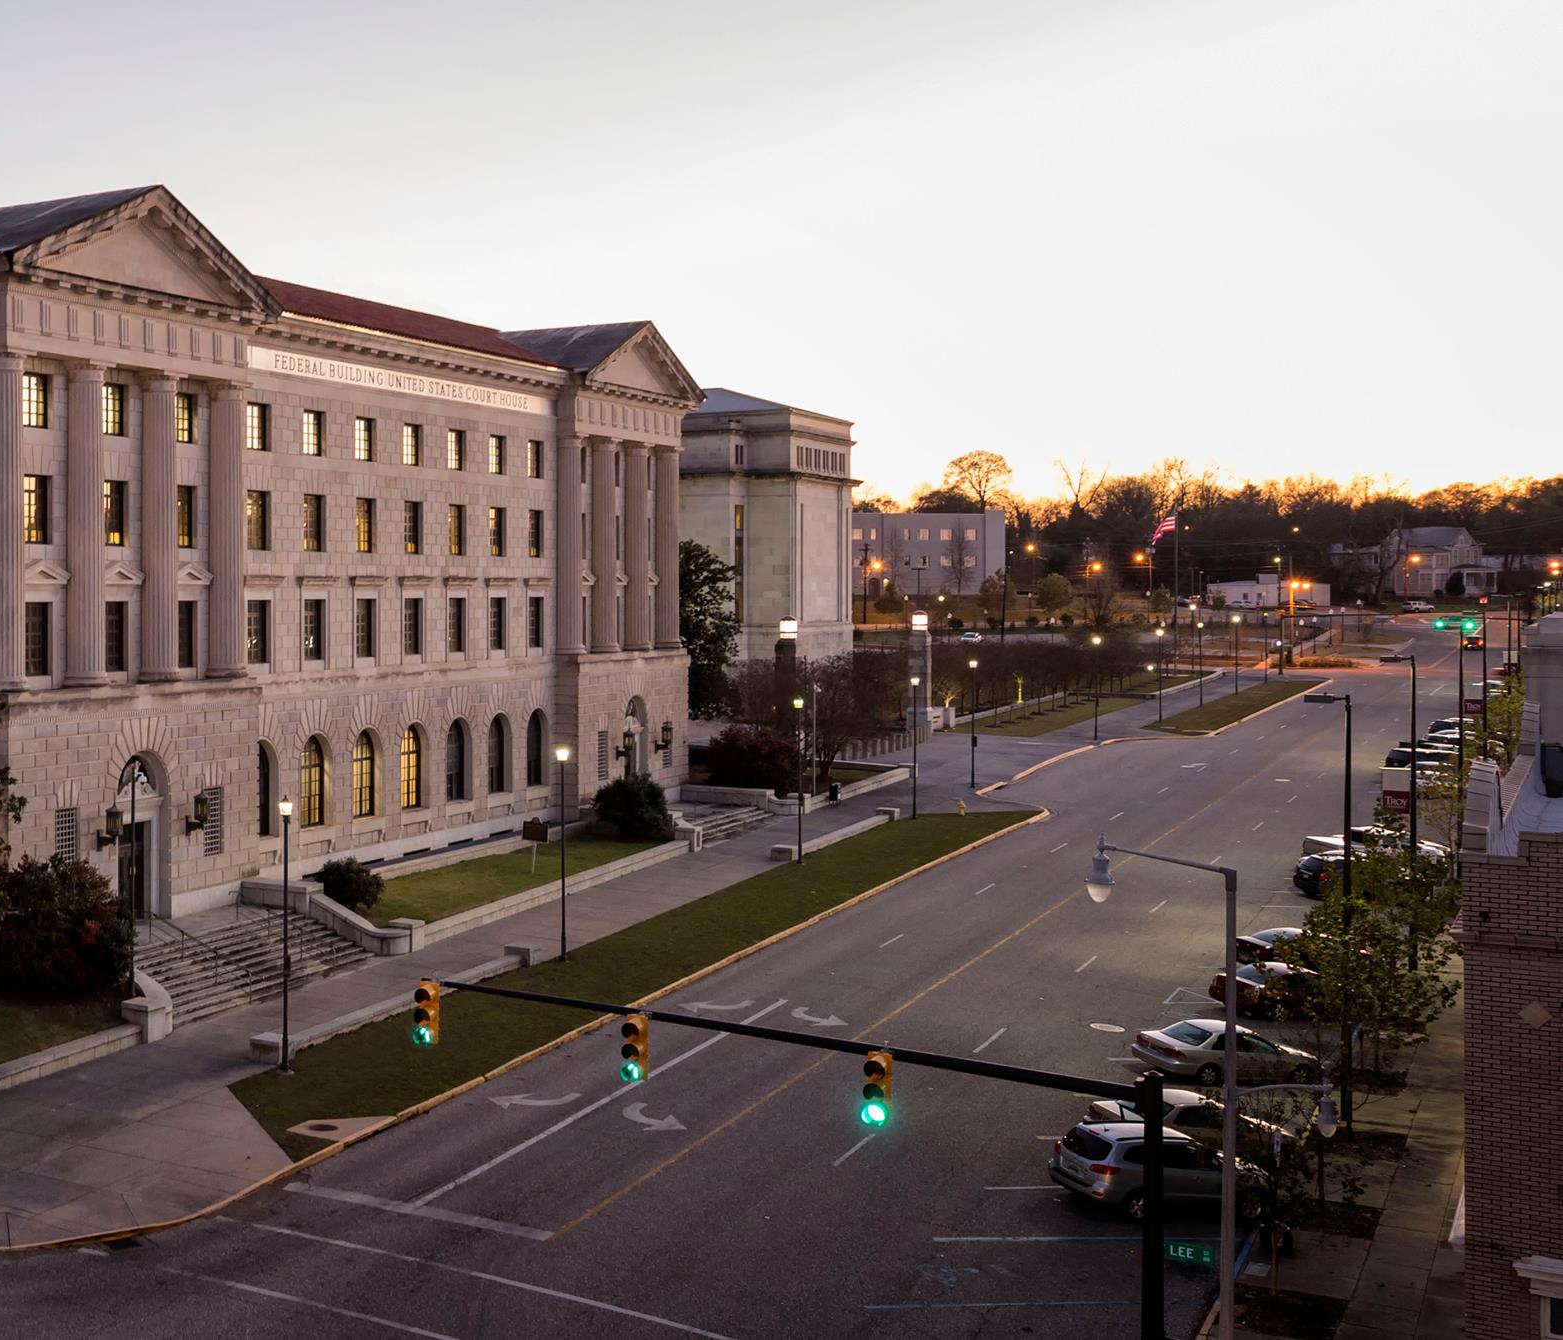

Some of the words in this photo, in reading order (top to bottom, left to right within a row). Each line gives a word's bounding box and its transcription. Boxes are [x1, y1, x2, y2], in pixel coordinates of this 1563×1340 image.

[274, 353, 326, 377] FEDERAL
[329, 363, 384, 386] BUILDING
[387, 372, 425, 392] UNITED
[428, 381, 463, 399] STATES
[465, 387, 497, 404] COURT
[499, 393, 528, 410] HOUSE
[1170, 1244, 1195, 1260] LEE
